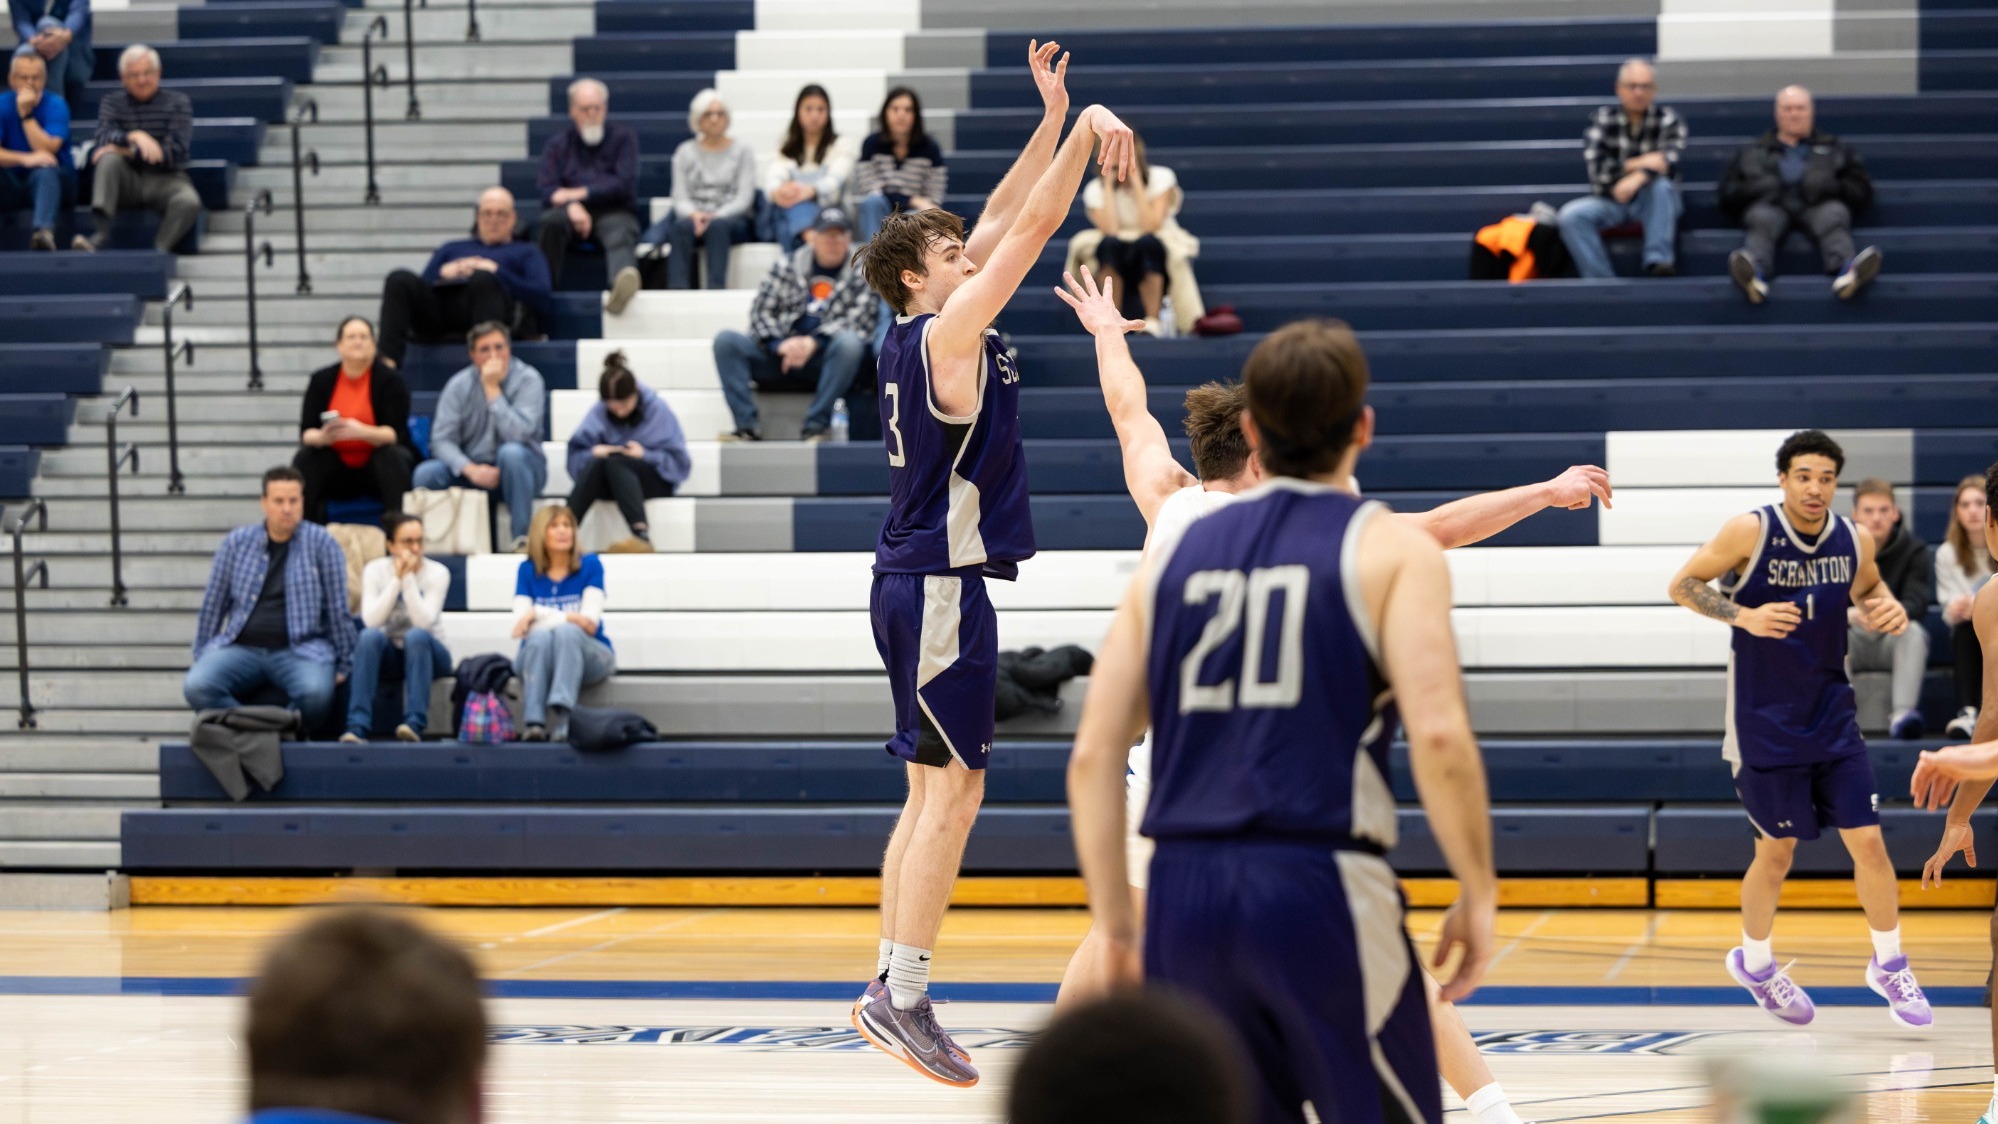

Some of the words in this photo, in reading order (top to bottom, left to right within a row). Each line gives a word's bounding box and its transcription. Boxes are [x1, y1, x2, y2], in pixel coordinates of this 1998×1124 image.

[884, 382, 906, 468] 3
[1768, 556, 1850, 587] SCRANTON
[1805, 593, 1814, 620] 1
[1178, 564, 1310, 717] 20
